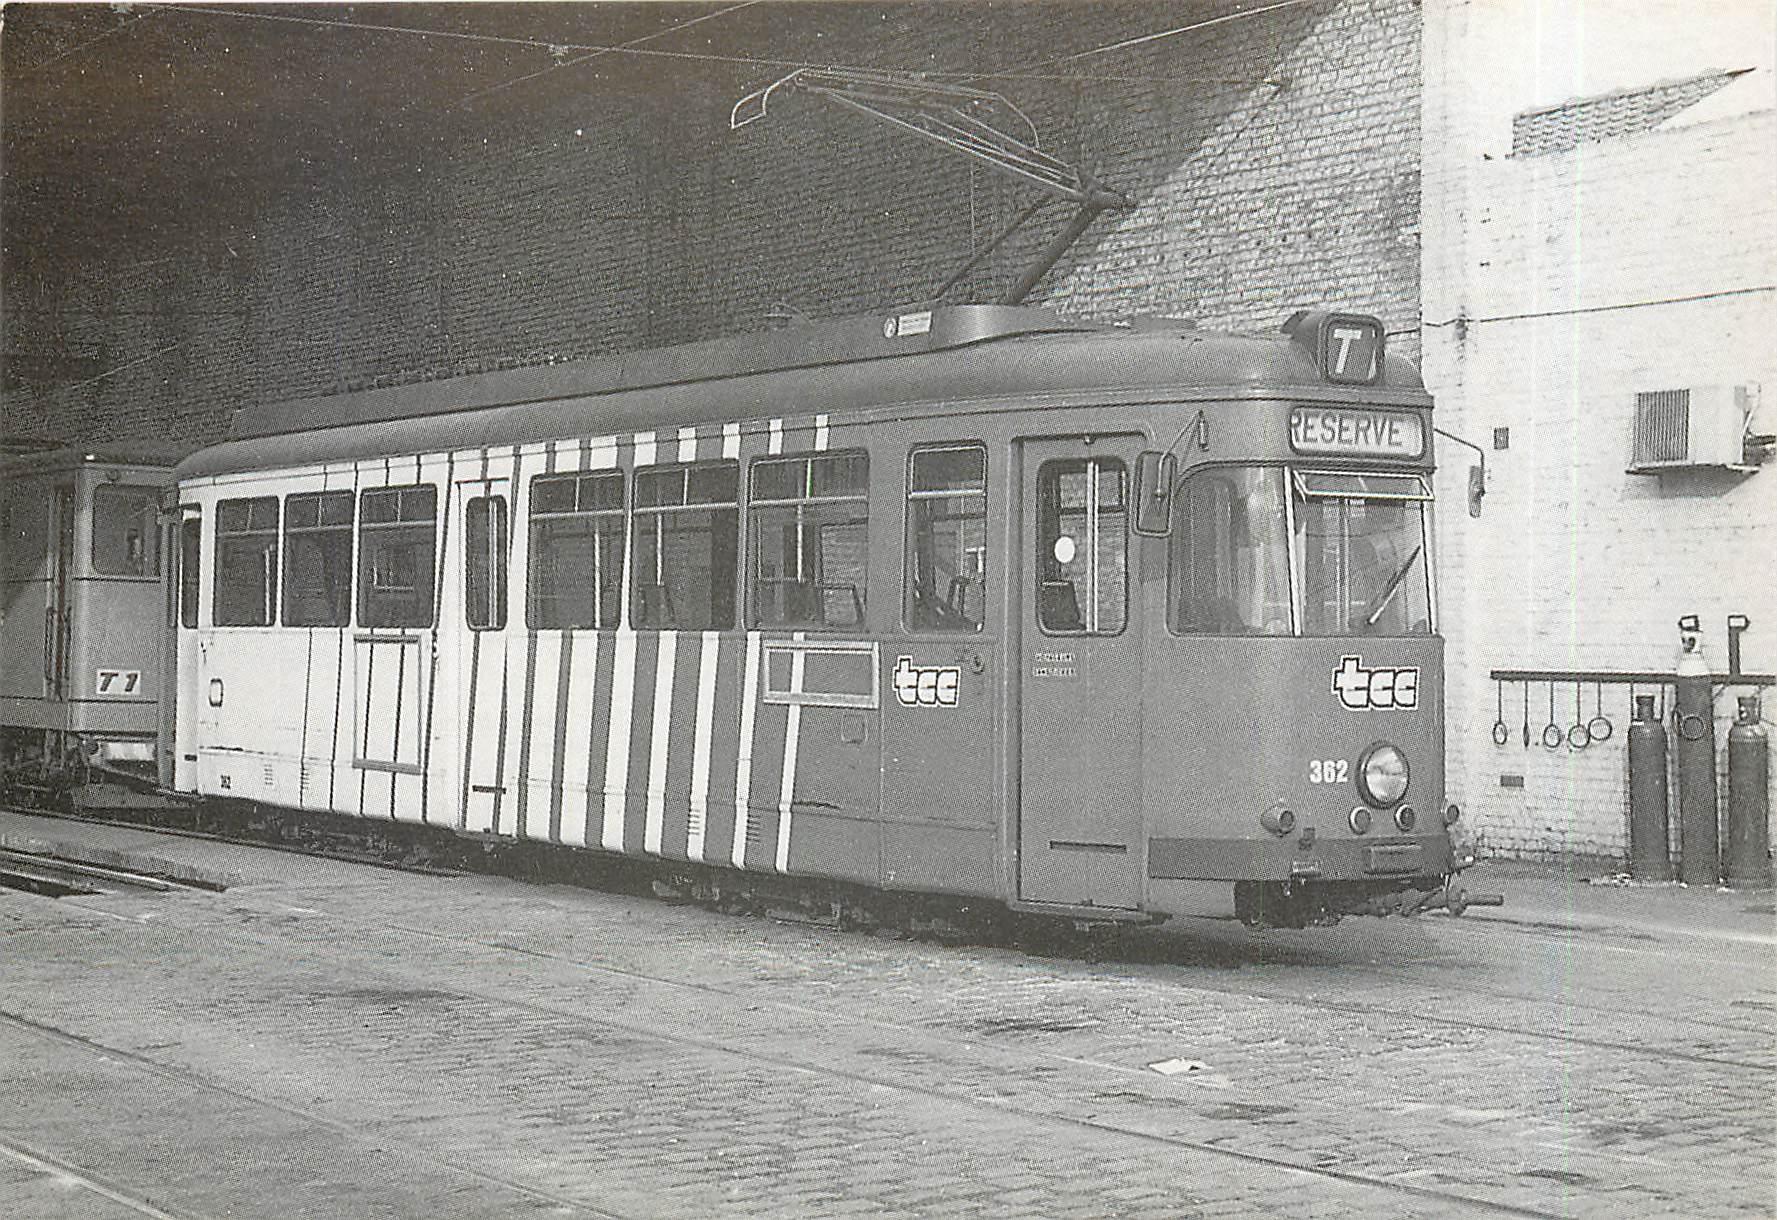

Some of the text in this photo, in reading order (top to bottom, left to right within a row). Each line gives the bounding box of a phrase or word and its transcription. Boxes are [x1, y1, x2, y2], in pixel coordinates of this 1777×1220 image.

[892, 656, 961, 707] tcc
[1331, 655, 1420, 711] tcc
[1309, 760, 1348, 783] 362
